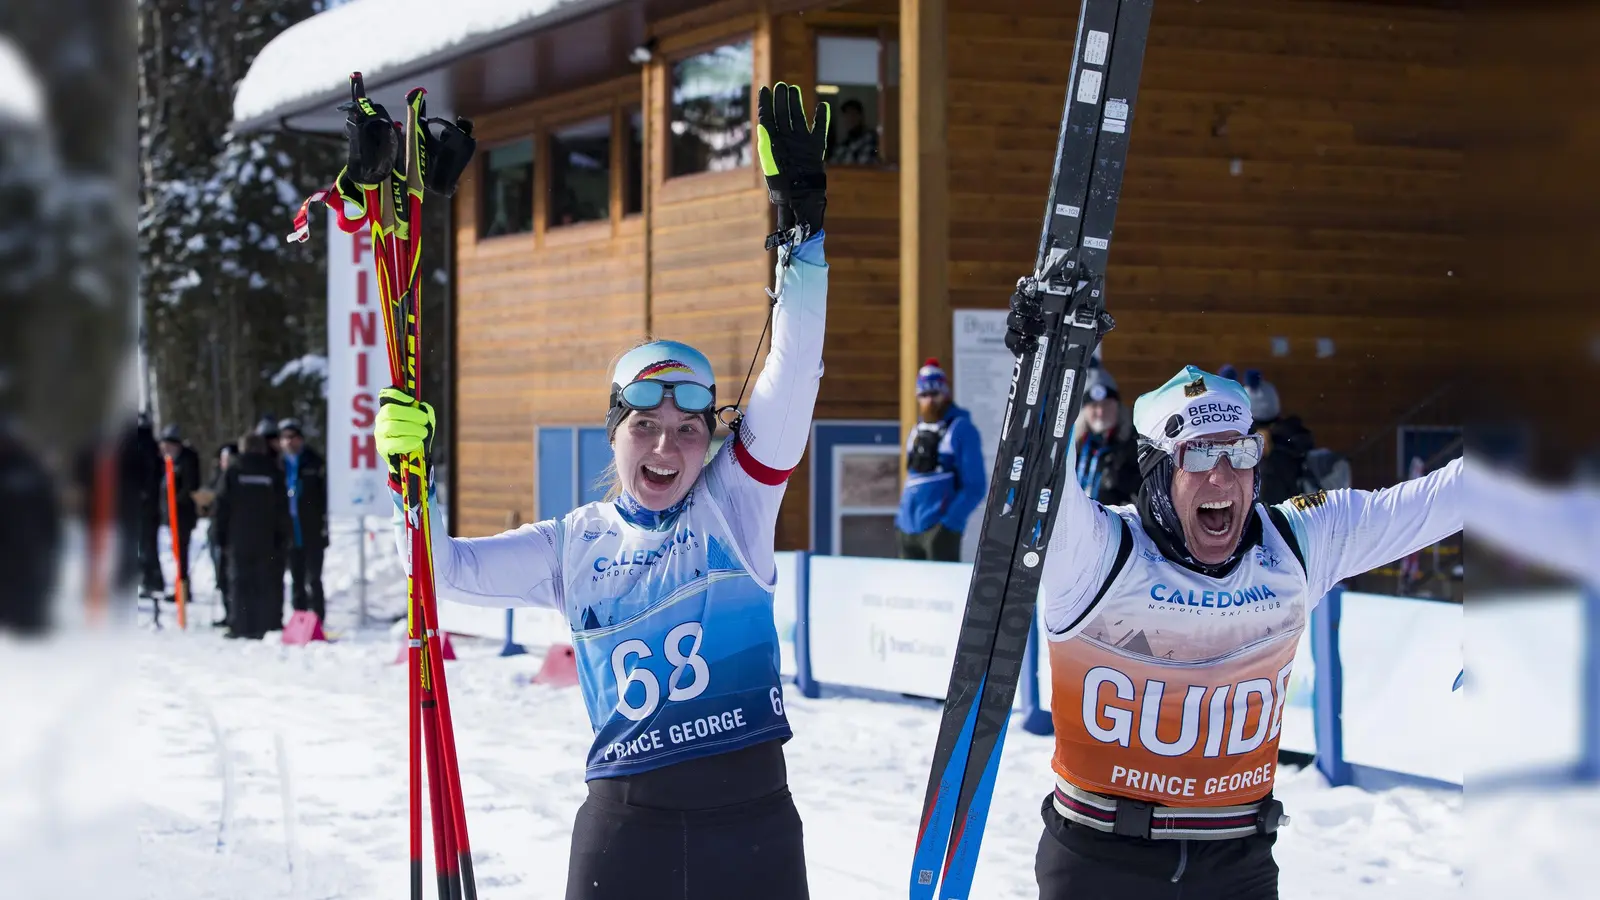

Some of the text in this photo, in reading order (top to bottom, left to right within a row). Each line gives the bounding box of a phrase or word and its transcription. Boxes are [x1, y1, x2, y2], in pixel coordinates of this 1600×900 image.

[358, 97, 377, 116] LEKI
[394, 182, 404, 213] LEKI
[350, 230, 377, 470] FINISH
[1056, 376, 1072, 430] PROLINK
[1188, 403, 1243, 417] BERLAC
[1190, 413, 1240, 426] GROUP
[592, 568, 634, 582] NORDIC
[1150, 583, 1277, 609] CALEDONIA
[1254, 601, 1281, 613] CLUB
[610, 621, 710, 721] 68
[669, 708, 747, 744] GEORGE
[1110, 762, 1272, 797] PRINCE GEORGE
